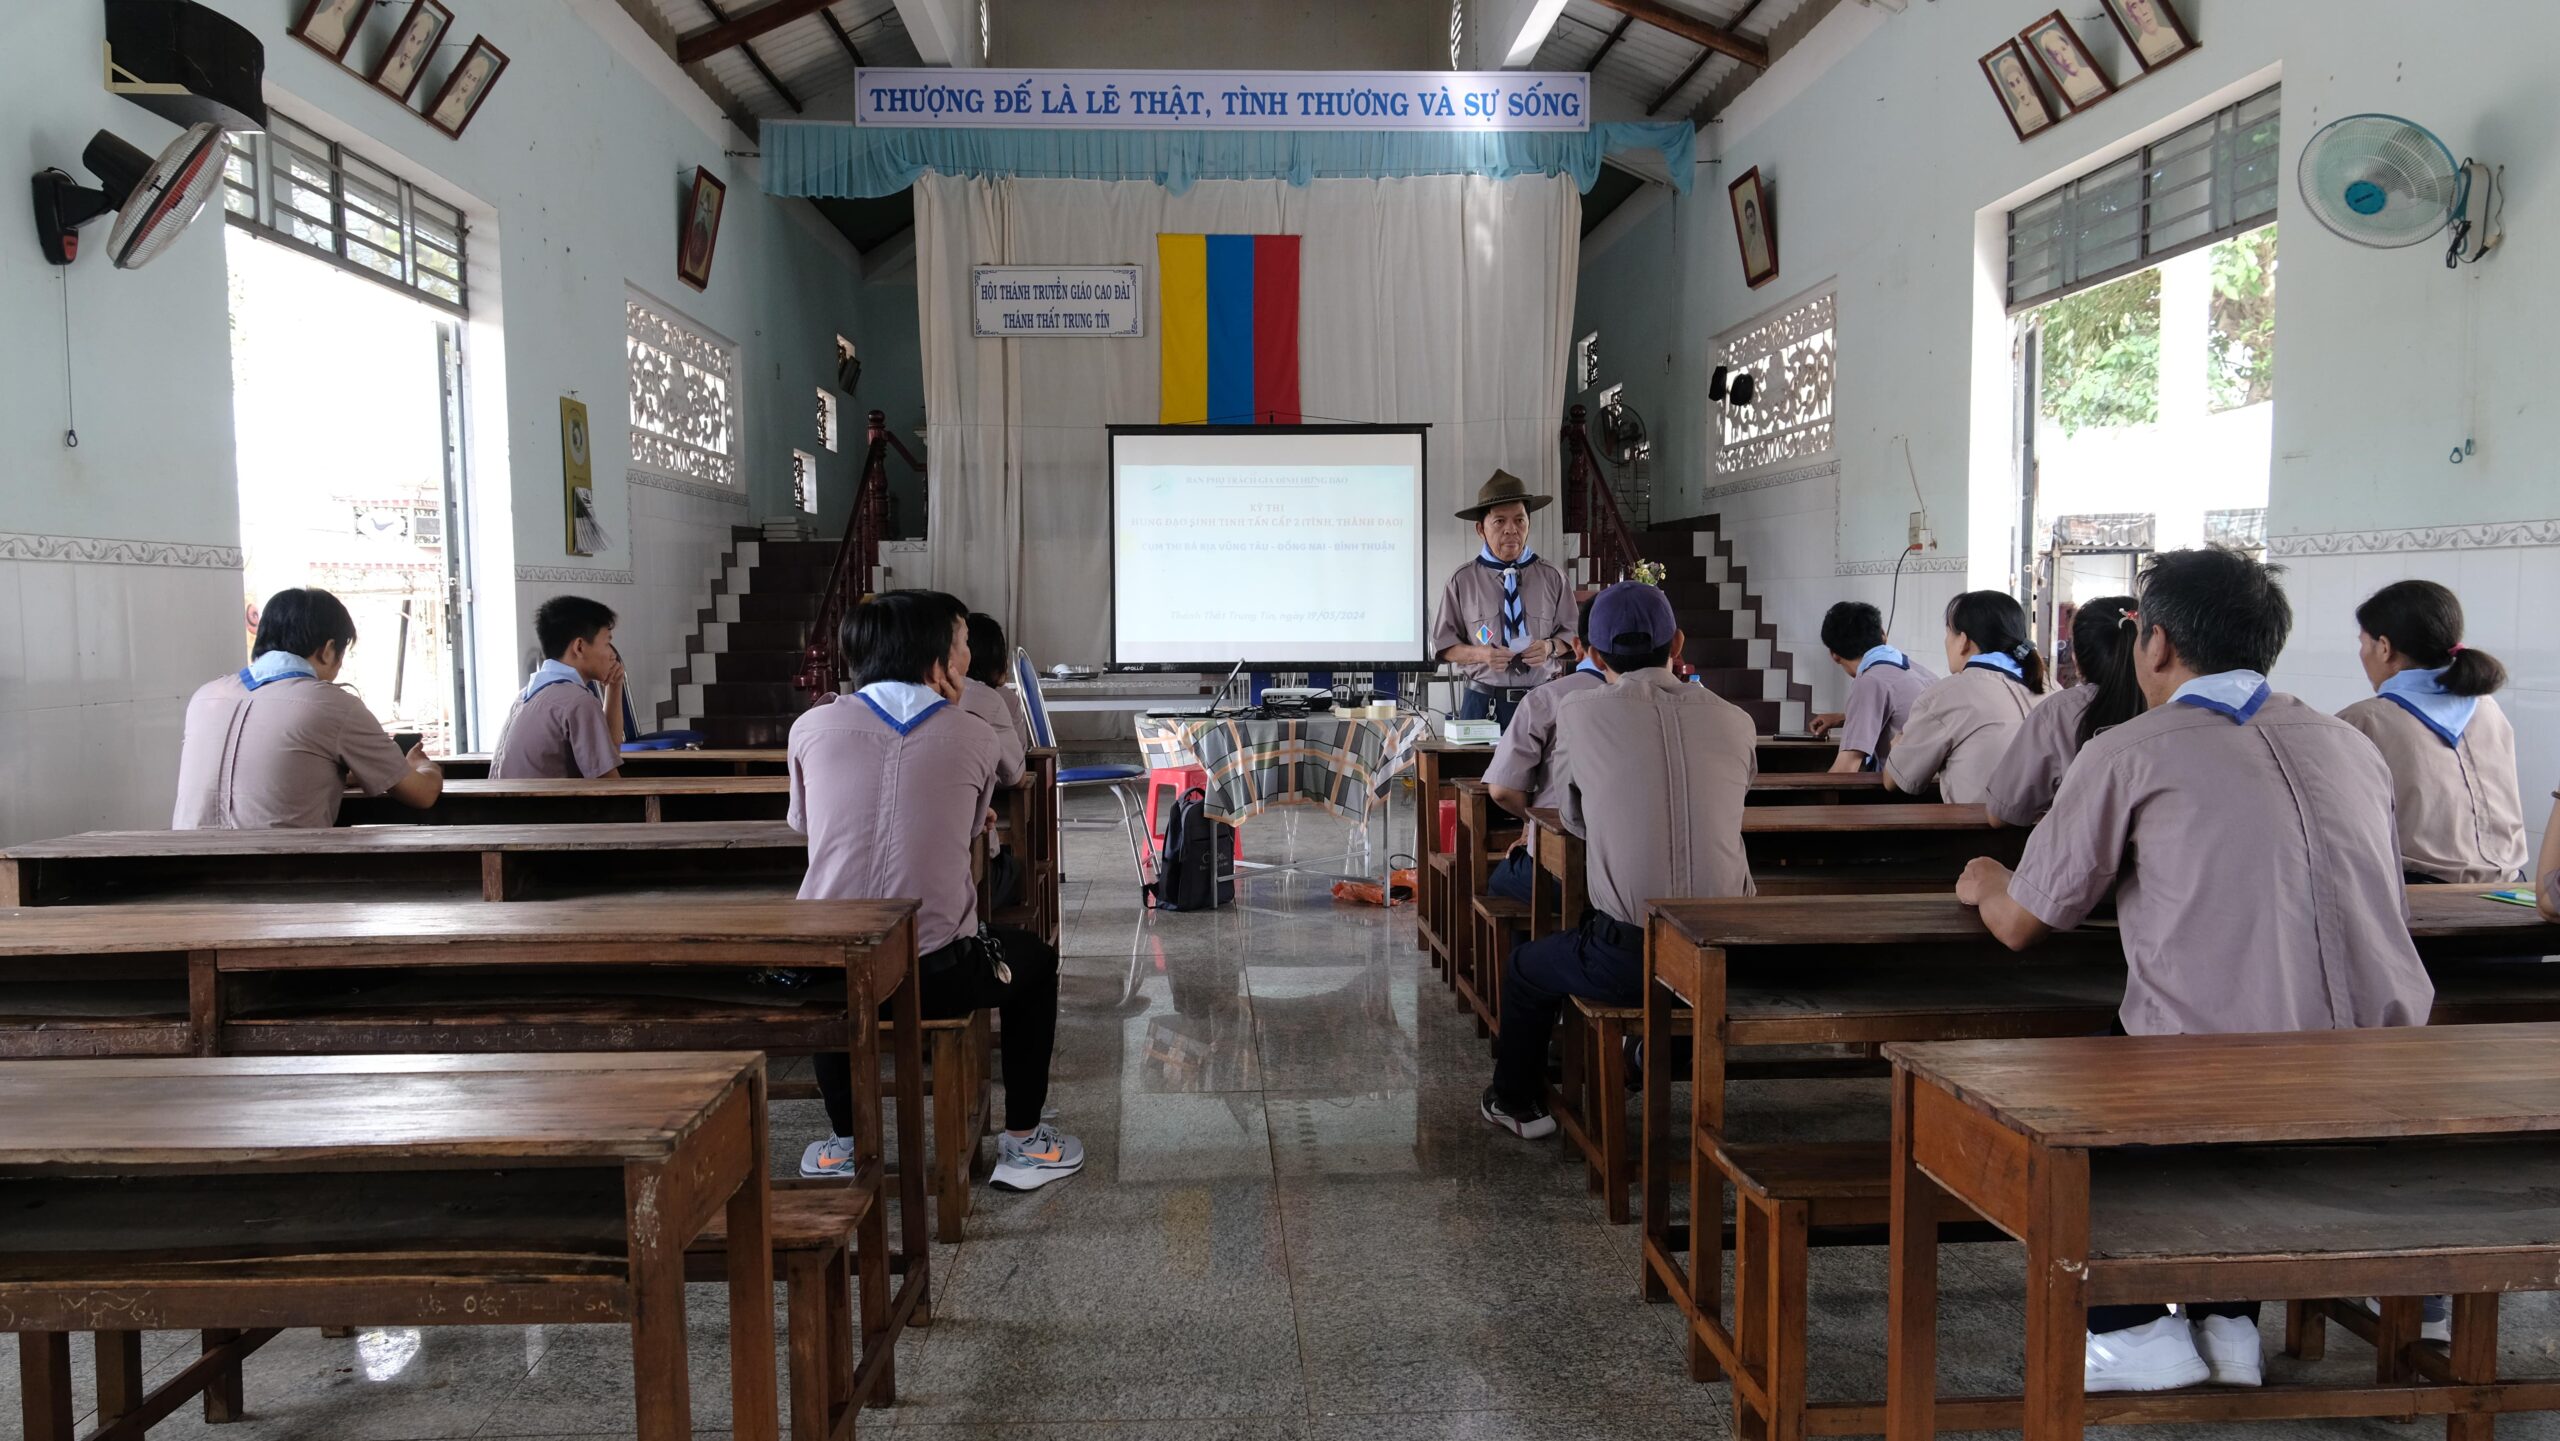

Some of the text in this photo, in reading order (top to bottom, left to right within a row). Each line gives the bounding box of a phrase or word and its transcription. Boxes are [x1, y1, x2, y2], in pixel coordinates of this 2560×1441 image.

[870, 78, 1581, 122] THƯỢNG ĐẾ LÀ LẼ THẬT, TÌNH THƯƠNG VÀ SỰ SỐNG
[981, 275, 1131, 304] HỘI THÁNH TRUYỀN GIÁO CAO ĐÀI
[1003, 306, 1110, 329] THÁNH THẤT TRUNG TÍN
